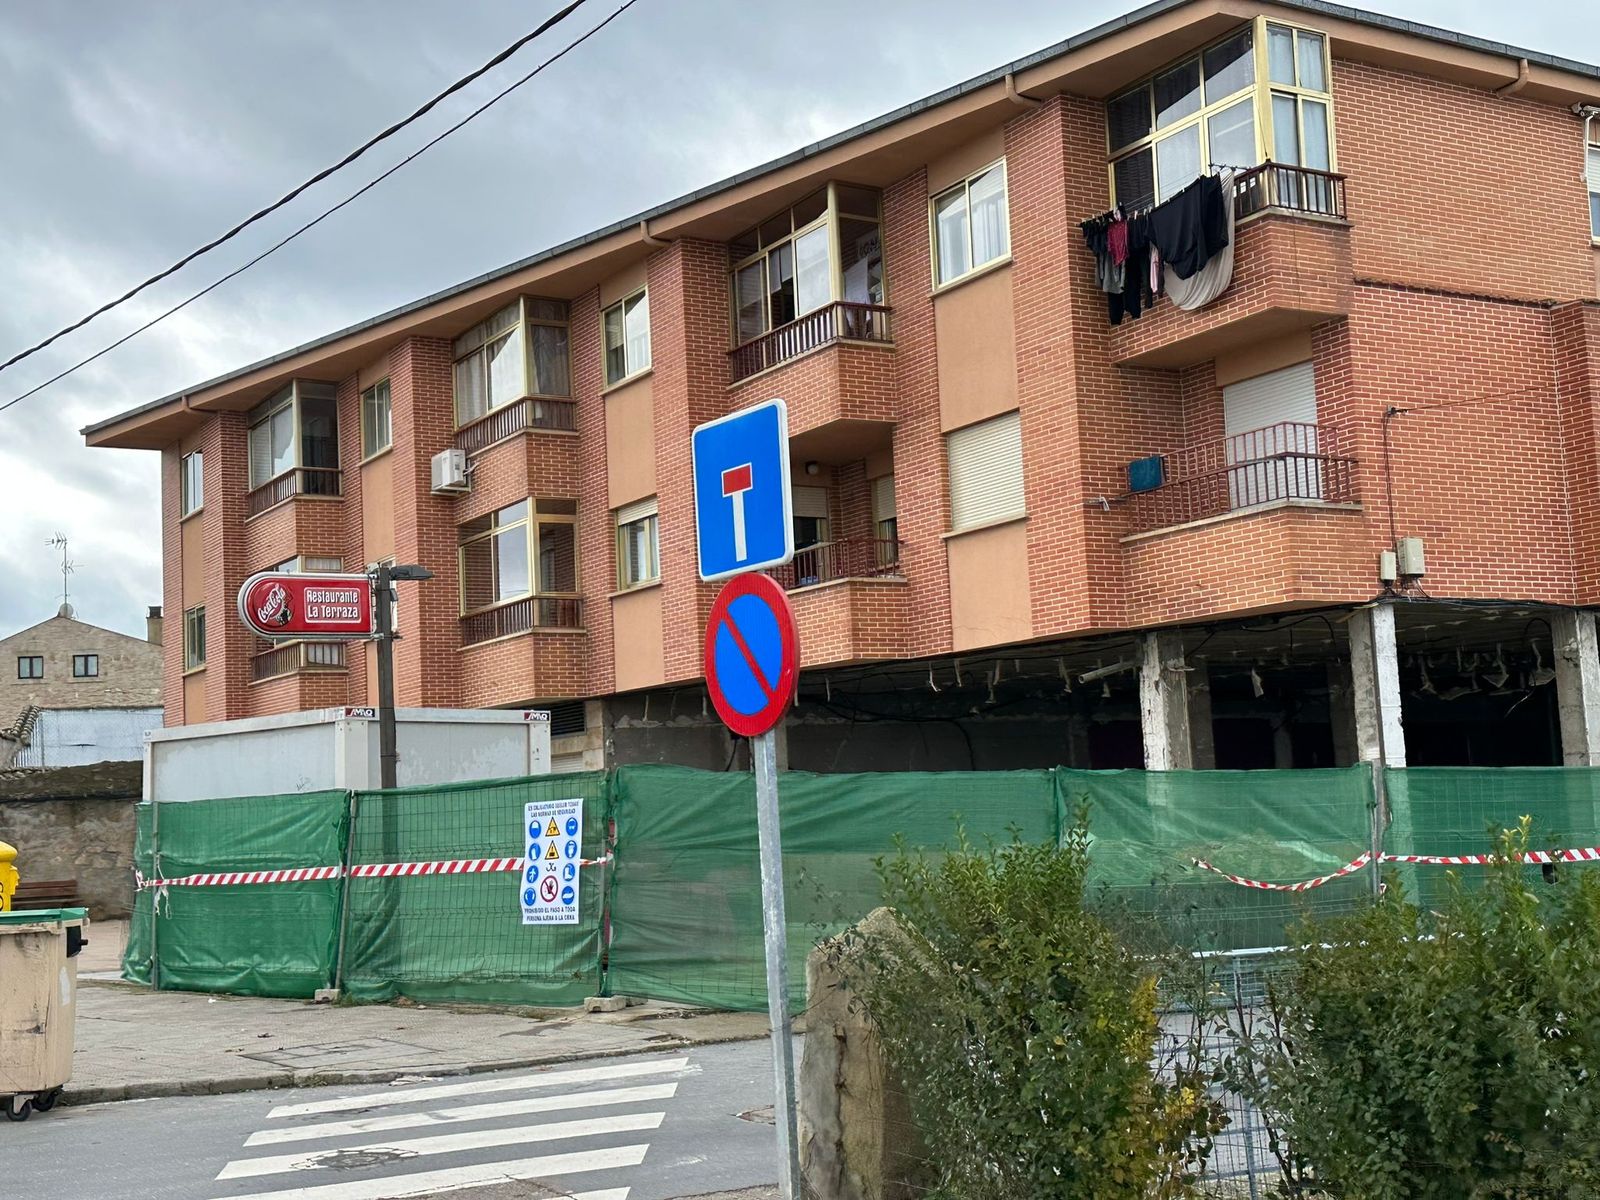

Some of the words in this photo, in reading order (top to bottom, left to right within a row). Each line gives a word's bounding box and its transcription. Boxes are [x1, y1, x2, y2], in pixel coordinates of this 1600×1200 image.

[307, 590, 358, 603] Restaurante
[307, 605, 318, 618] La
[321, 606, 358, 618] Terraza
